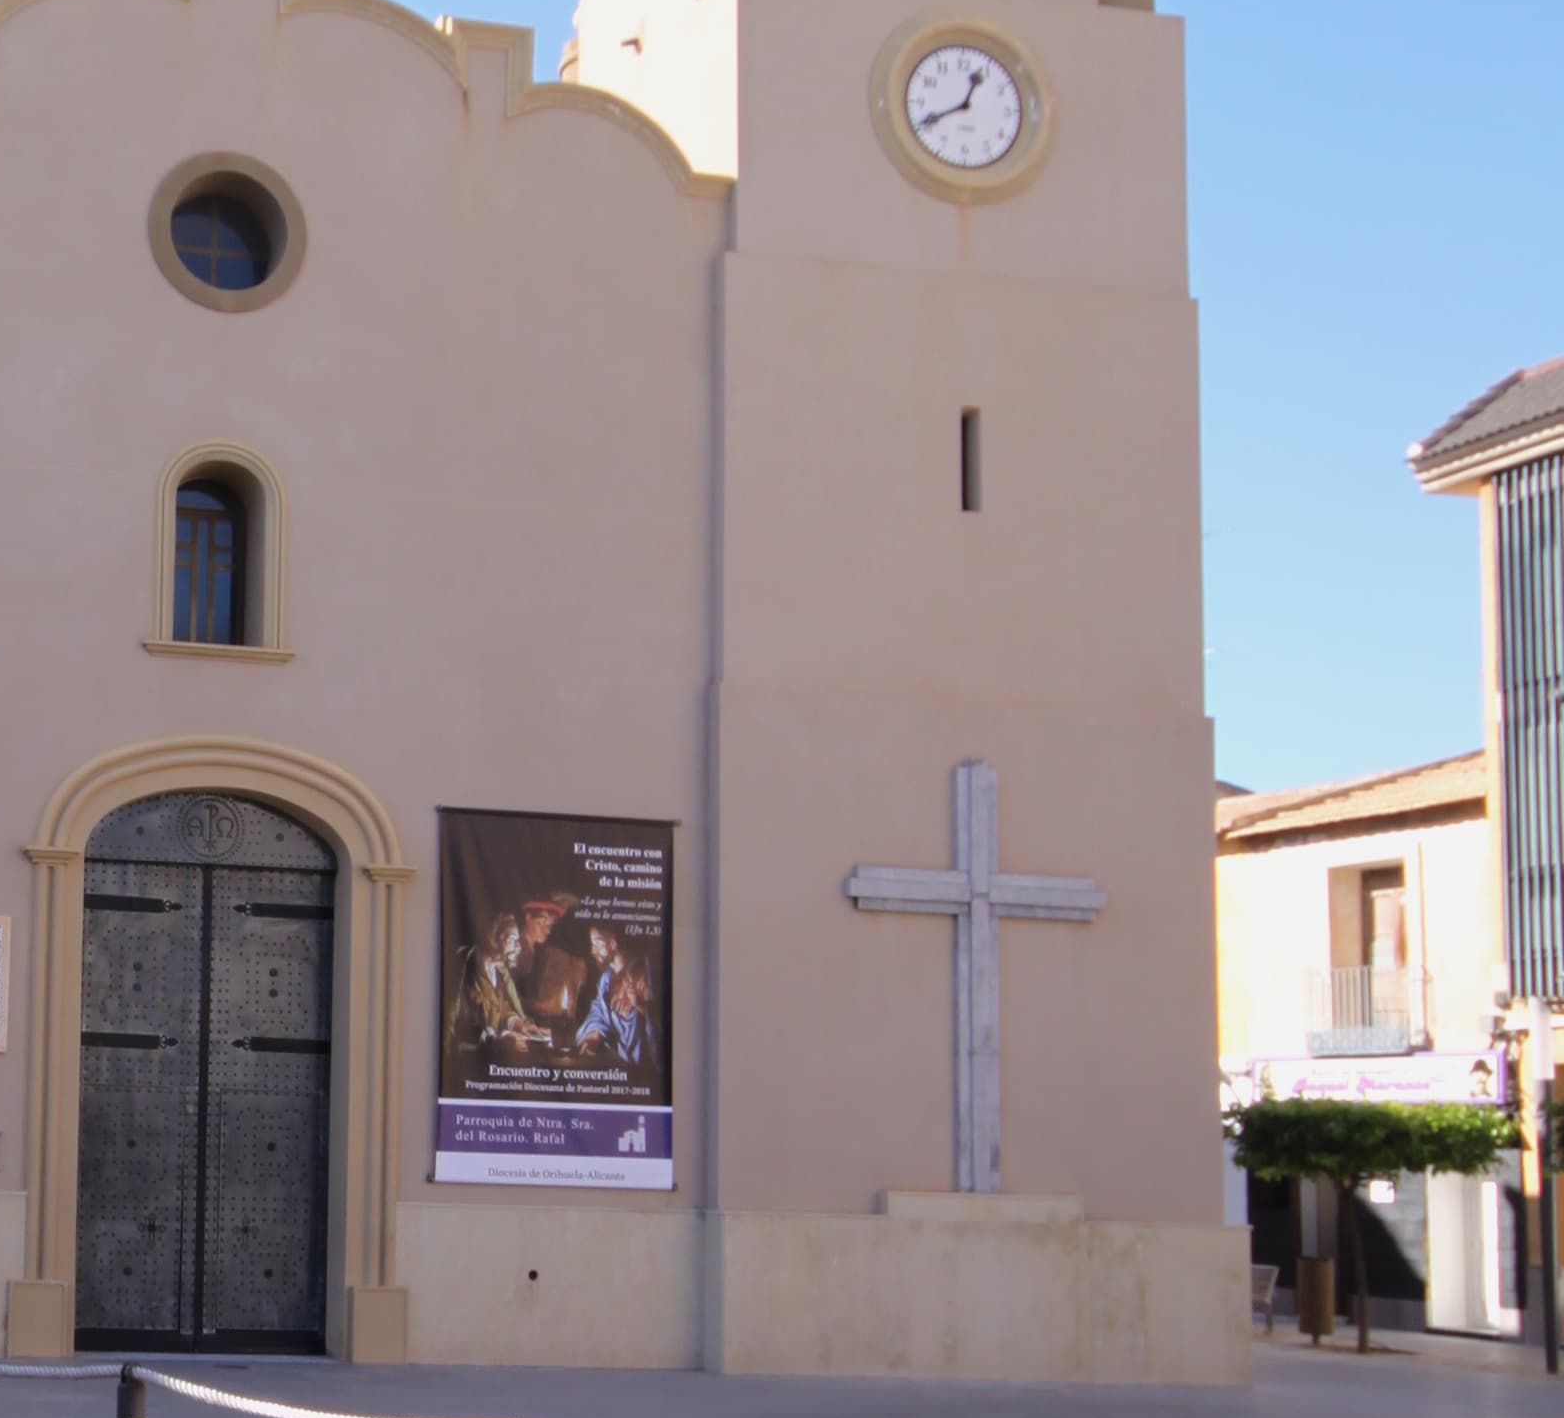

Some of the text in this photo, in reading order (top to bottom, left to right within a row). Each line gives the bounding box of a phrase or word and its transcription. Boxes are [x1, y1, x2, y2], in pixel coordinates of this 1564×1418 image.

[574, 842, 662, 859] El encuentro con
[585, 859, 663, 874] Cristo, camino
[599, 875, 662, 890] de la misión
[488, 1064, 628, 1082] Encuentro y conversión
[465, 1080, 523, 1092] Programación
[523, 1082, 564, 1093] Diocesana
[565, 1083, 575, 1093] de
[576, 1084, 610, 1094] Pastoral
[456, 1114, 595, 1130] Parroquia de Ntra. Sra.
[455, 1130, 565, 1146] del Rosario. Rafal
[529, 1168, 540, 1178] de
[542, 1168, 625, 1181] Orihuela-Alicante
